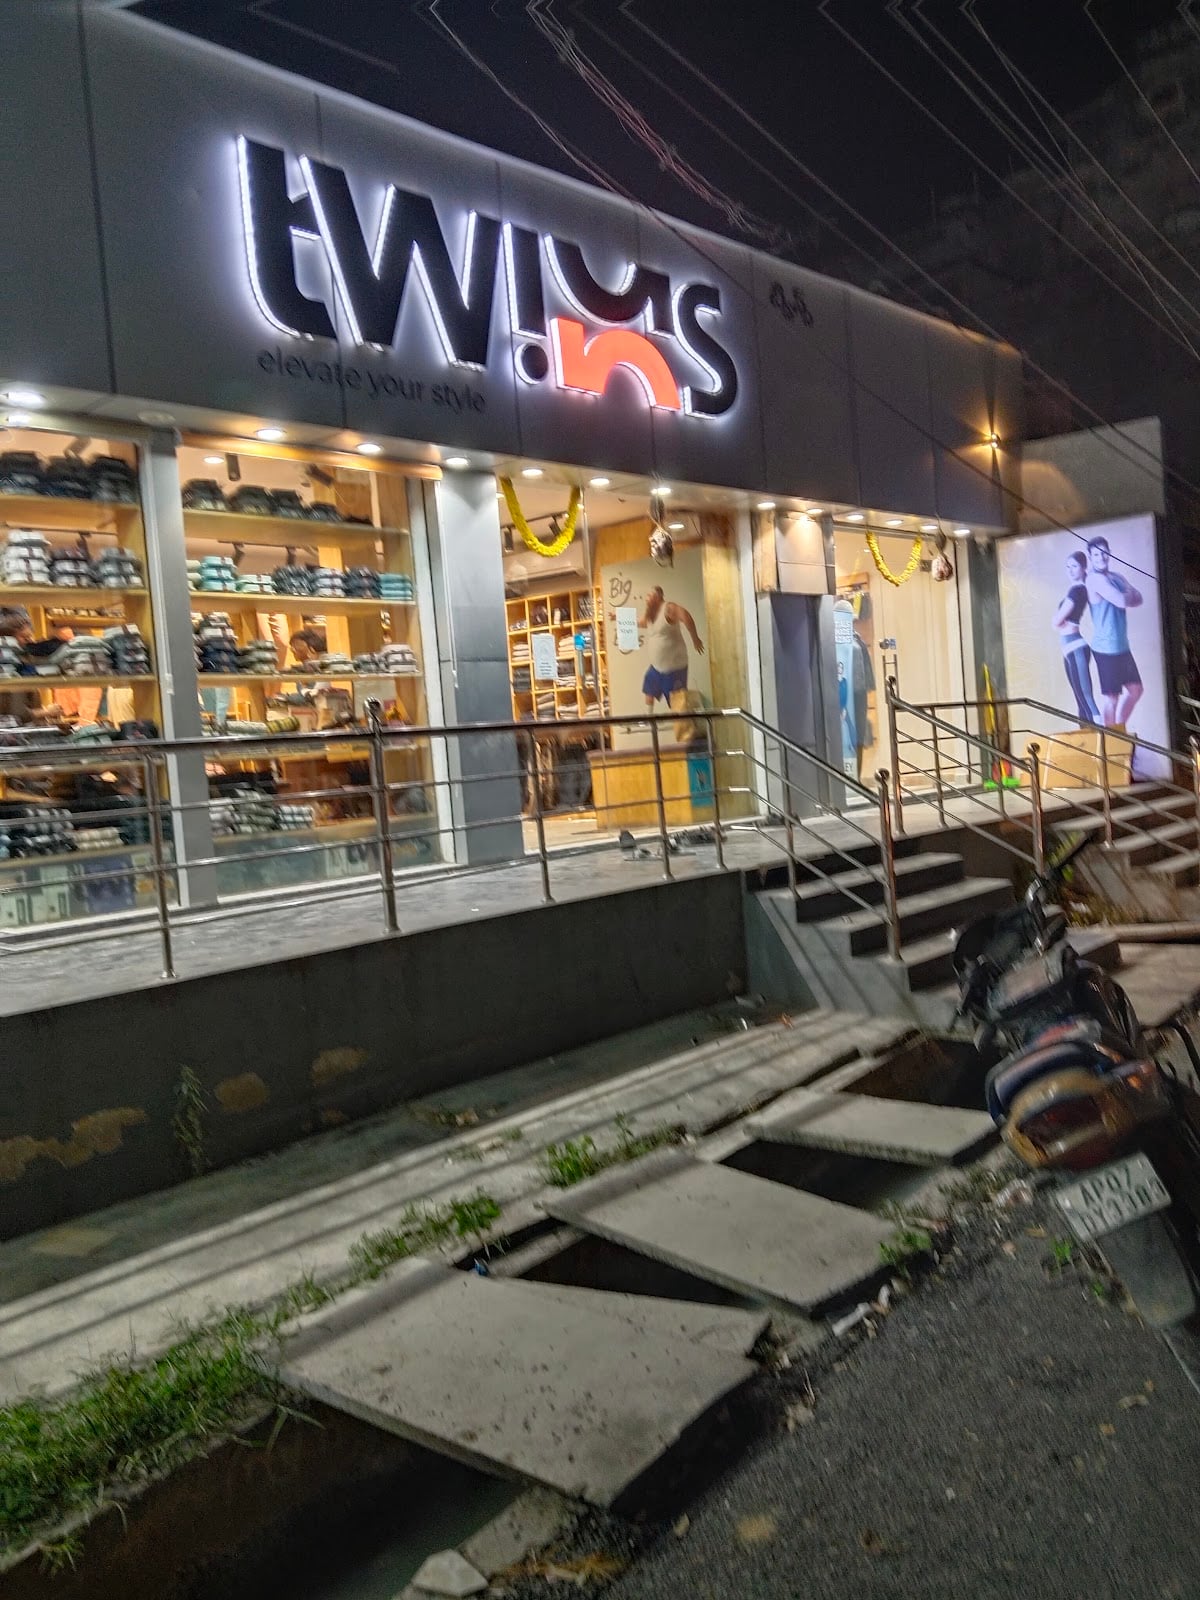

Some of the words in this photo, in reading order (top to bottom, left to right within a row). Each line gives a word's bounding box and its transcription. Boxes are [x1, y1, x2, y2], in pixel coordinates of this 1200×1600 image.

[257, 347, 361, 391] elevate
[366, 370, 424, 402] your
[430, 383, 486, 414] style
